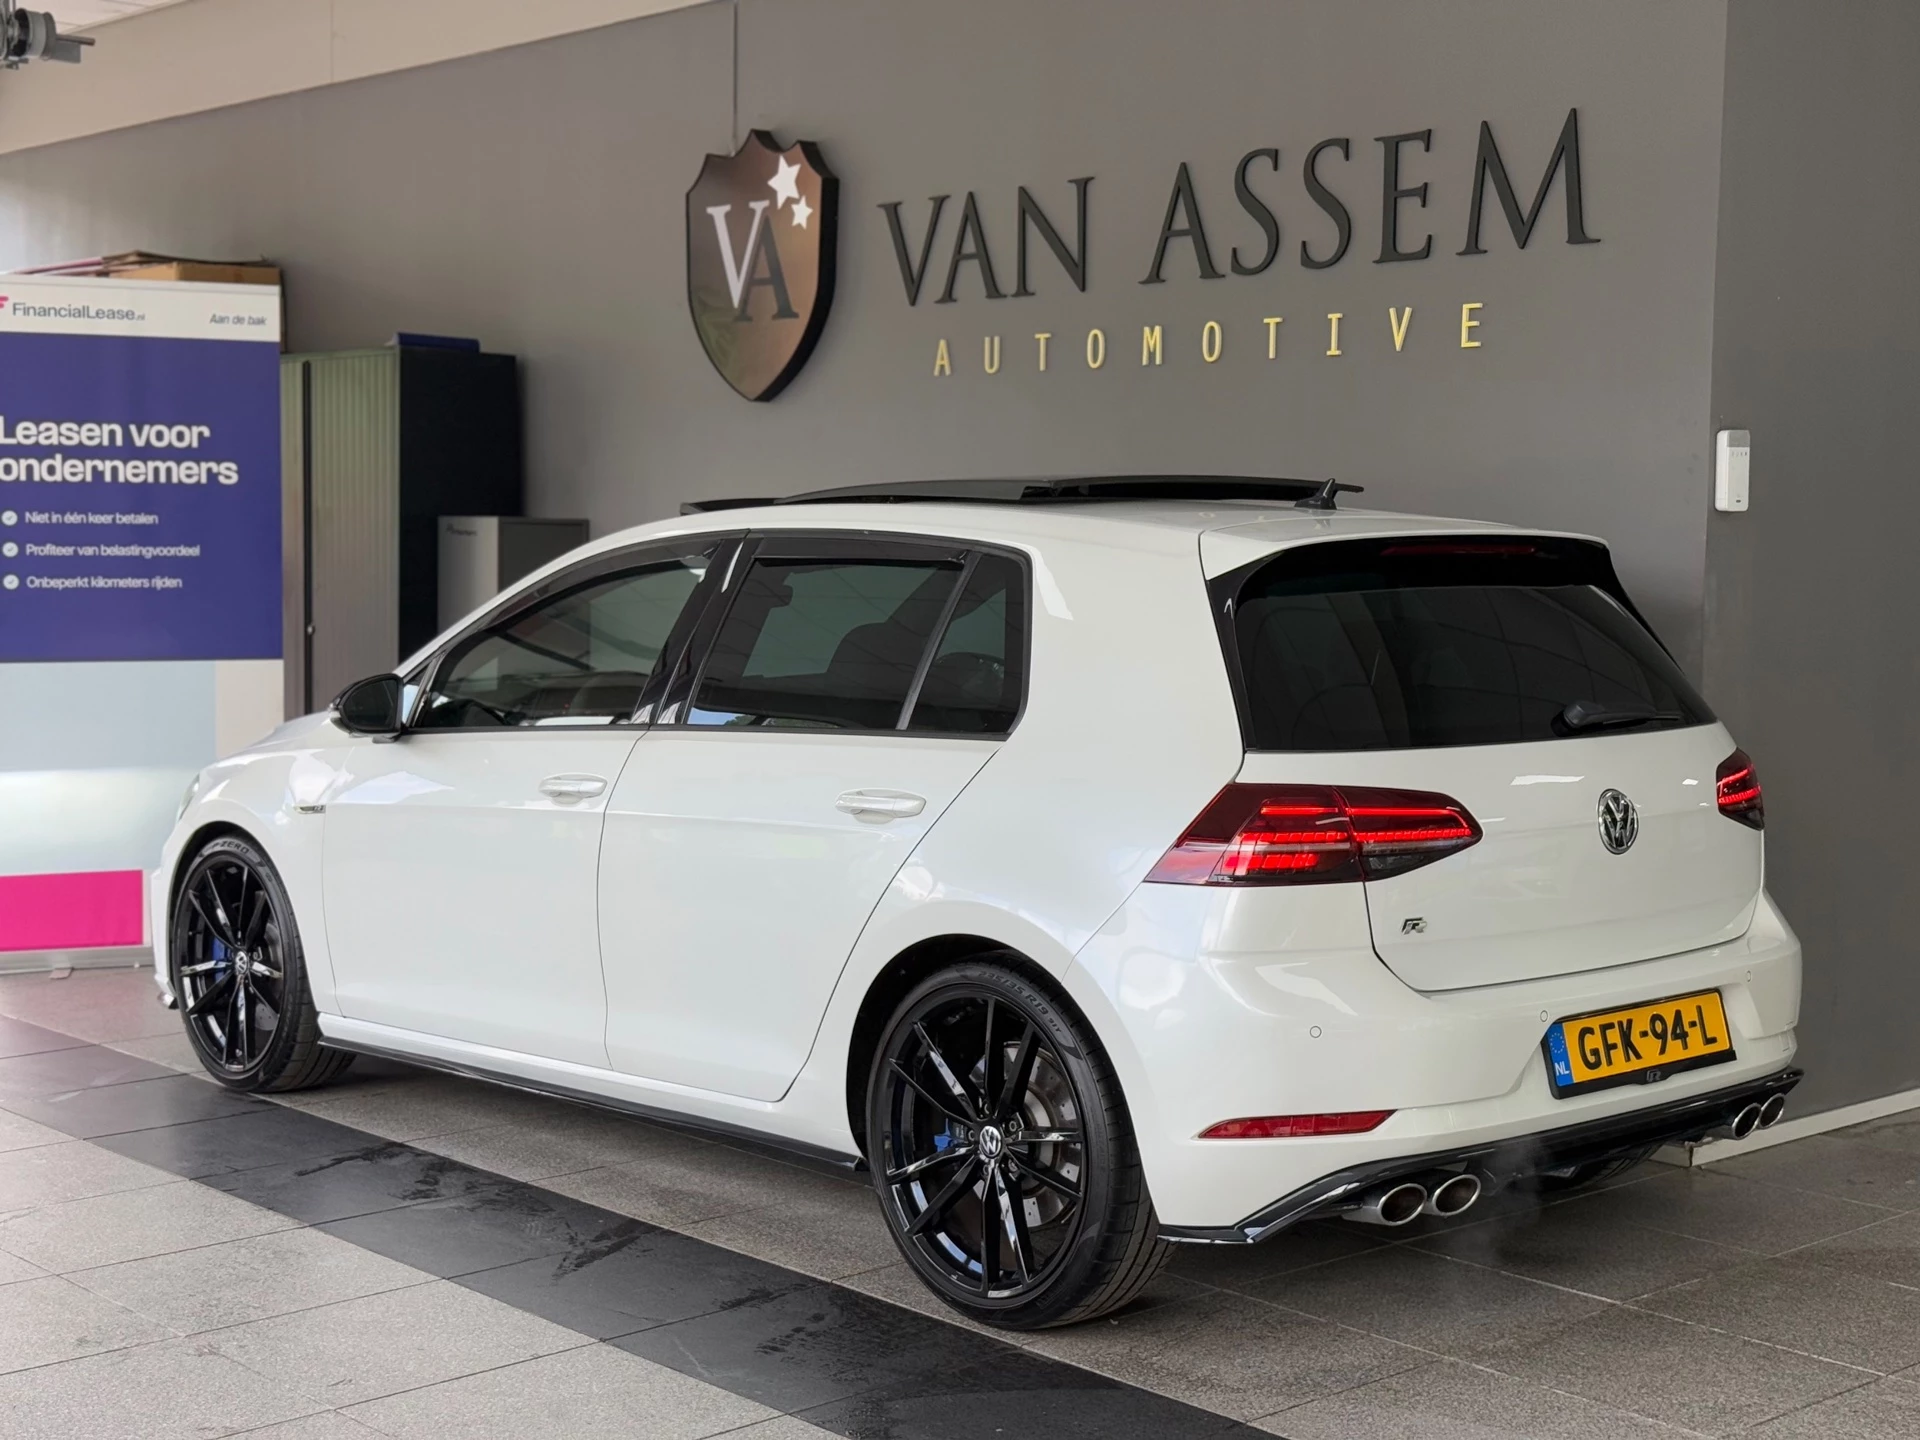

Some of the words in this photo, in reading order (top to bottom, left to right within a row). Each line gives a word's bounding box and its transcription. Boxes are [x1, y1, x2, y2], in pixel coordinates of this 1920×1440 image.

[876, 176, 1095, 307] VAN
[1138, 107, 1602, 285] ASSEM
[209, 313, 230, 325] Aan
[231, 314, 246, 326] de
[247, 315, 268, 326] bak
[933, 302, 1484, 377] AUTOMOTIVE
[0, 415, 123, 447] Leasen
[128, 423, 211, 448] voor
[0, 453, 239, 485] ondernemers
[25, 511, 49, 524] Niet
[51, 511, 62, 524] in
[64, 512, 87, 525] één
[88, 512, 115, 525] keer
[116, 512, 159, 525] betalen
[26, 543, 75, 557] Profiteer
[77, 547, 99, 557] van
[100, 544, 201, 559] belastingvoordeel
[26, 576, 89, 591] Onbeperkt
[90, 577, 150, 589] kilometers
[151, 577, 183, 591] rijden
[1577, 1004, 1718, 1071] GFK-94-L
[1554, 1062, 1570, 1077] NL
